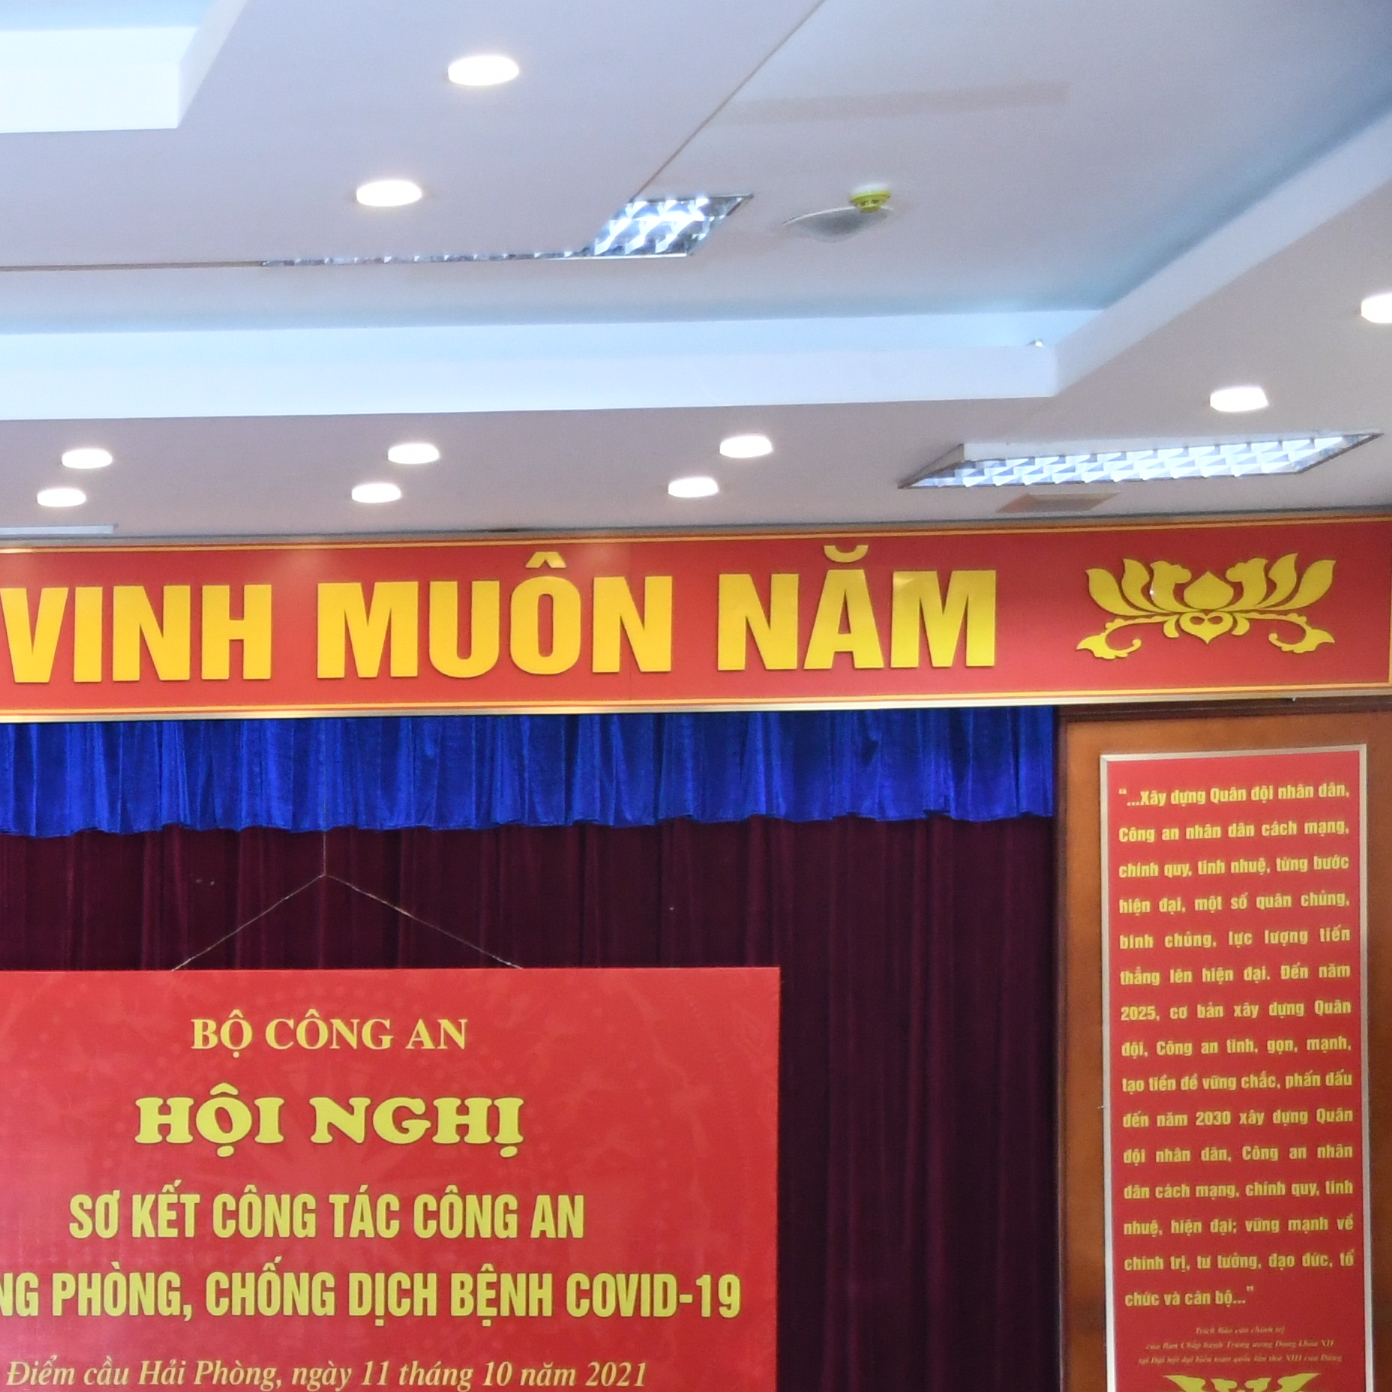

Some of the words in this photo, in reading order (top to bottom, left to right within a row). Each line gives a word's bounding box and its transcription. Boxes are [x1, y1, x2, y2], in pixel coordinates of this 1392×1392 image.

[0, 584, 272, 684] VINH
[316, 552, 672, 680] MUÔN
[718, 544, 997, 671] NĂM
[190, 1008, 253, 1058] BỘ
[264, 1007, 394, 1050] CÔNG
[404, 1018, 468, 1050] AN
[134, 1081, 285, 1157] HỘI
[308, 1096, 524, 1158] NGHỊ
[68, 1188, 121, 1239] SƠ
[131, 1178, 201, 1238] KẾT
[212, 1183, 317, 1238] CÔNG
[328, 1183, 400, 1239] TÁC
[413, 1183, 518, 1239] CÔNG
[530, 1194, 584, 1239] AN
[51, 1260, 193, 1322] PHÒNG,
[205, 1255, 335, 1316] CHỐNG
[348, 1271, 437, 1326] DỊCH
[450, 1262, 553, 1327] BỆNH
[566, 1272, 741, 1318] COVID-19
[6, 1356, 79, 1389] Điểm
[82, 1353, 130, 1386] cầu
[137, 1358, 187, 1385] Hải
[193, 1358, 282, 1392] Phòng,
[291, 1359, 353, 1392] ngày
[360, 1360, 389, 1386] 11
[398, 1359, 474, 1392] tháng
[482, 1360, 513, 1386] 10
[519, 1361, 576, 1386] năm
[584, 1361, 646, 1387] 2021
